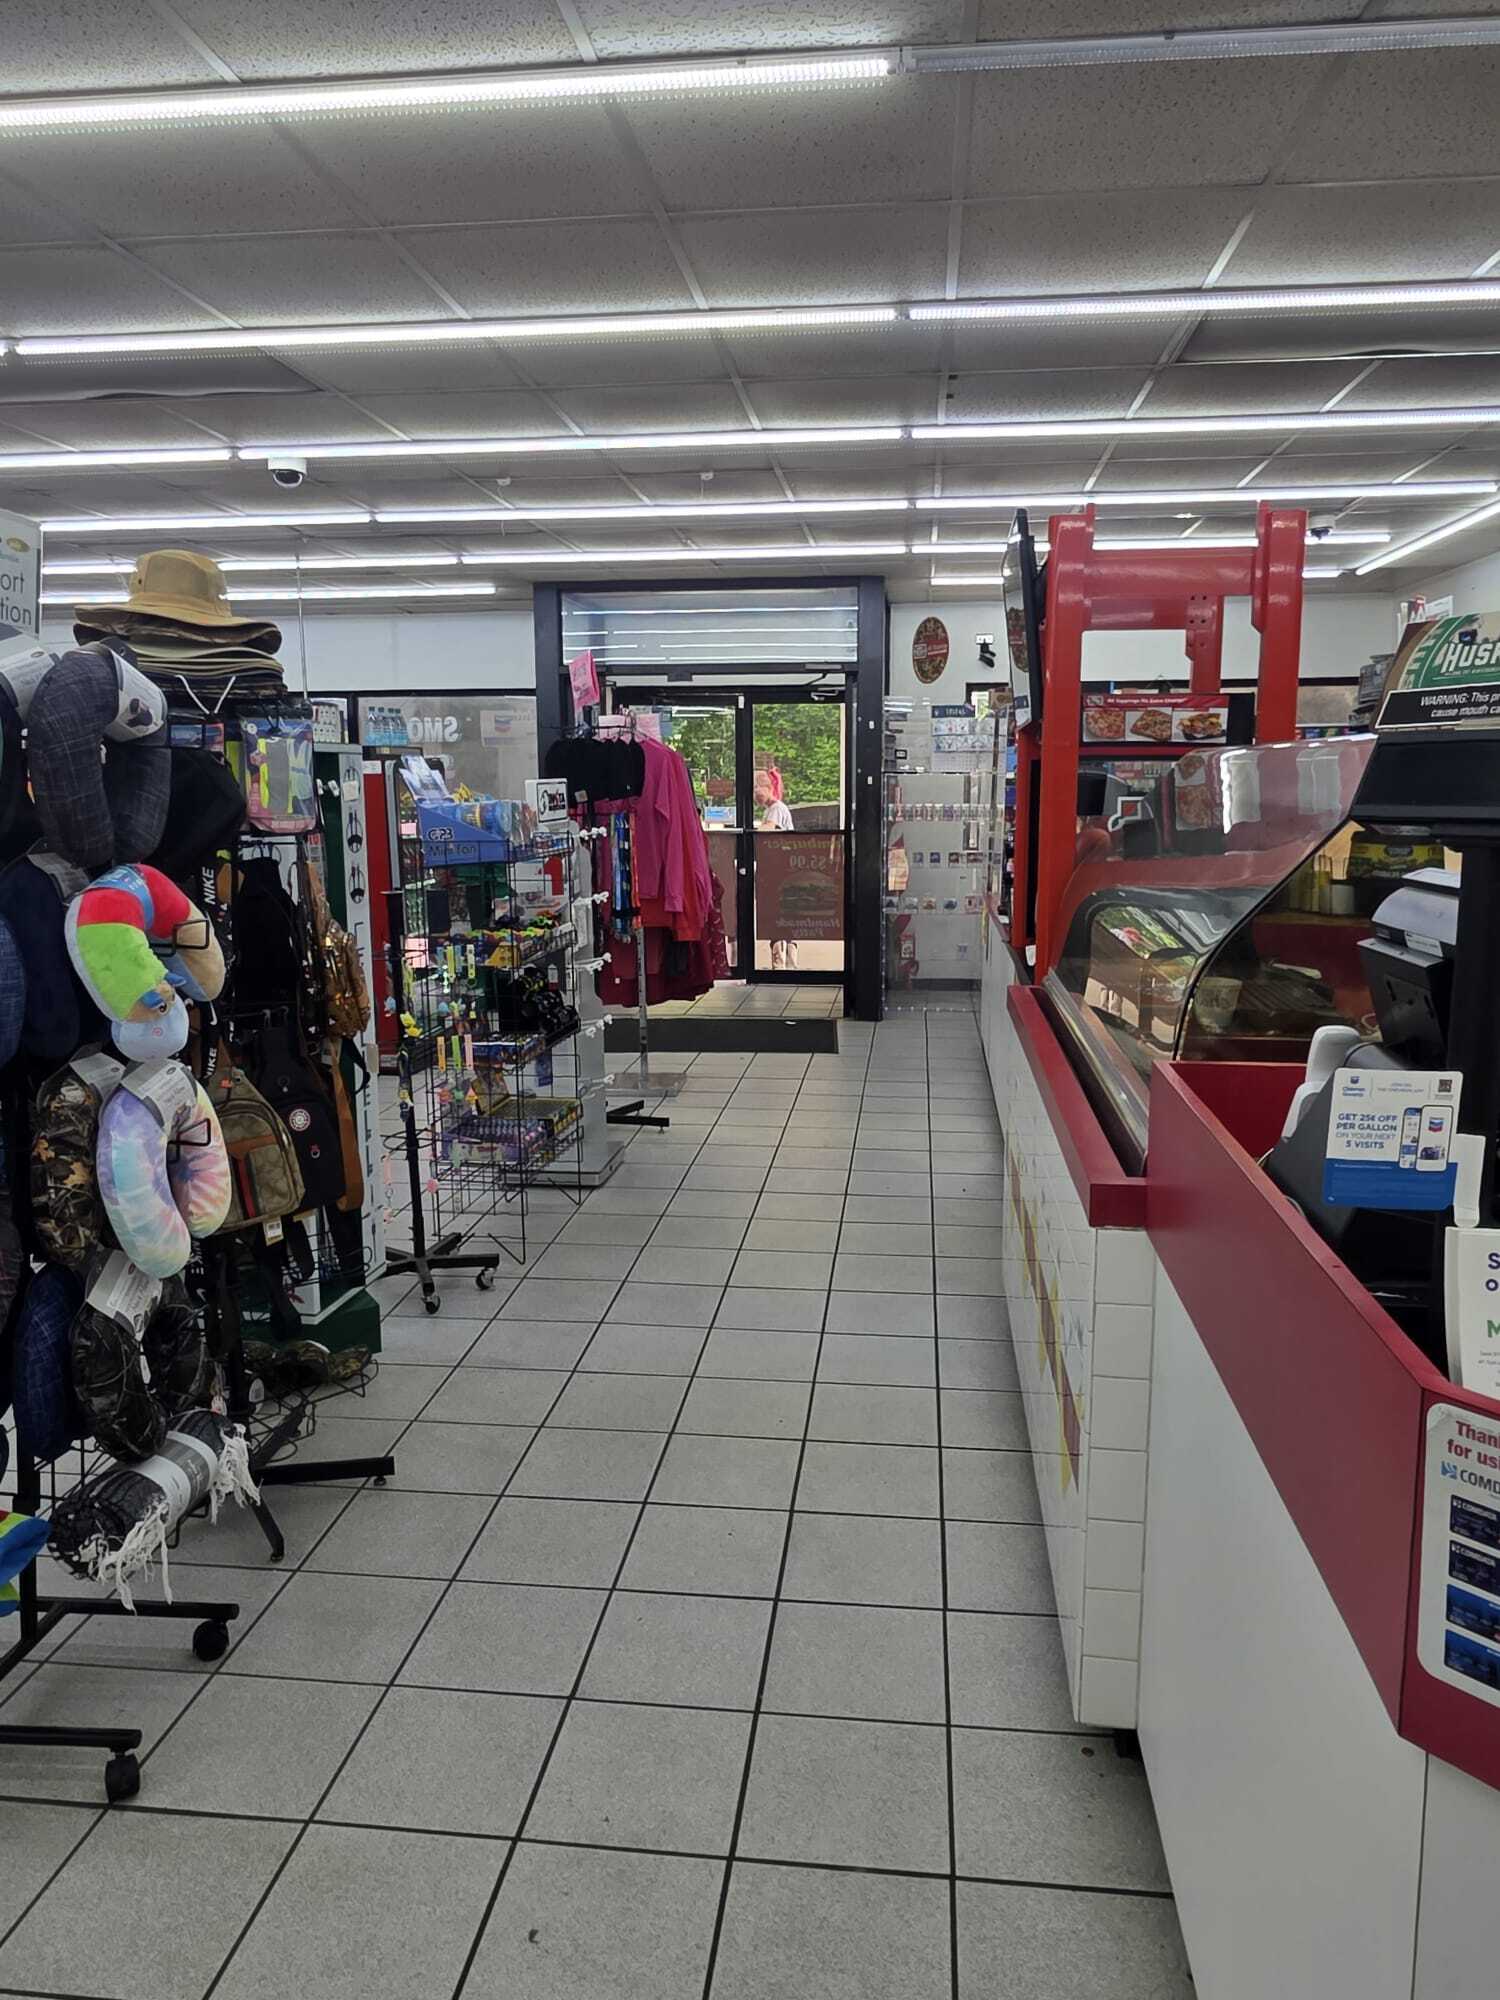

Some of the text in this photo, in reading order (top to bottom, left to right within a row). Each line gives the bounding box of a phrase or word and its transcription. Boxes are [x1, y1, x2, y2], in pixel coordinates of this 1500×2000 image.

[0, 572, 25, 595] ort
[1420, 692, 1470, 707] WARNING:
[1471, 691, 1490, 703] This
[202, 866, 216, 905] NIKE
[1337, 1113, 1357, 1121] GET
[1336, 1122, 1397, 1132] PER GALLON
[1345, 1140, 1384, 1149] 5 VISITS
[1448, 1438, 1472, 1459] for
[1460, 1469, 1500, 1495] COMD
